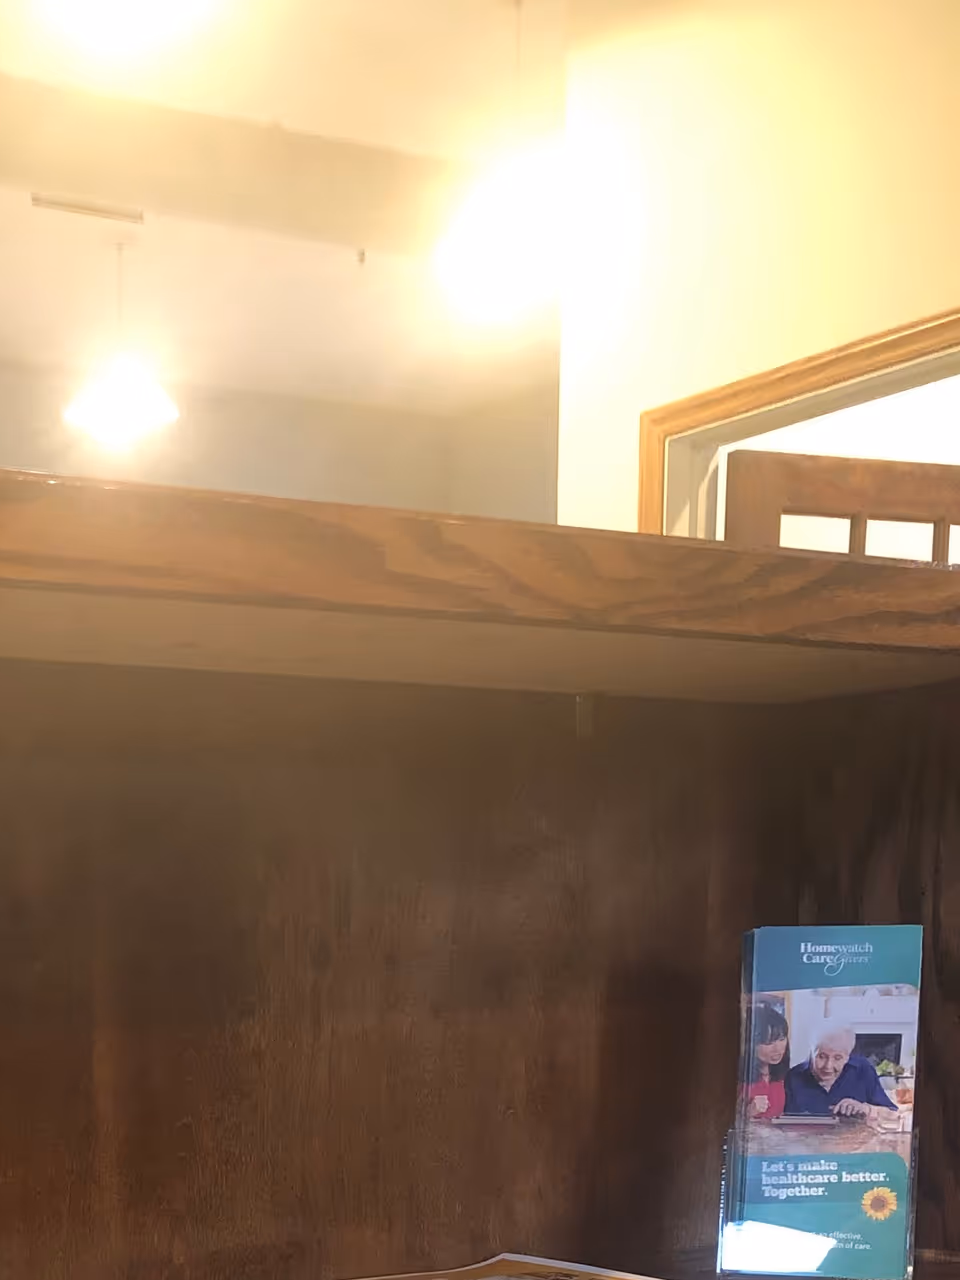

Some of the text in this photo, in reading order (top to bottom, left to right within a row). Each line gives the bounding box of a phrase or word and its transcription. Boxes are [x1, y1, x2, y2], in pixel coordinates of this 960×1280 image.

[800, 942, 873, 953] Homewatch
[761, 1160, 838, 1172] Let's make
[761, 1171, 889, 1185] healthcare better.
[761, 1185, 828, 1200] Together.
